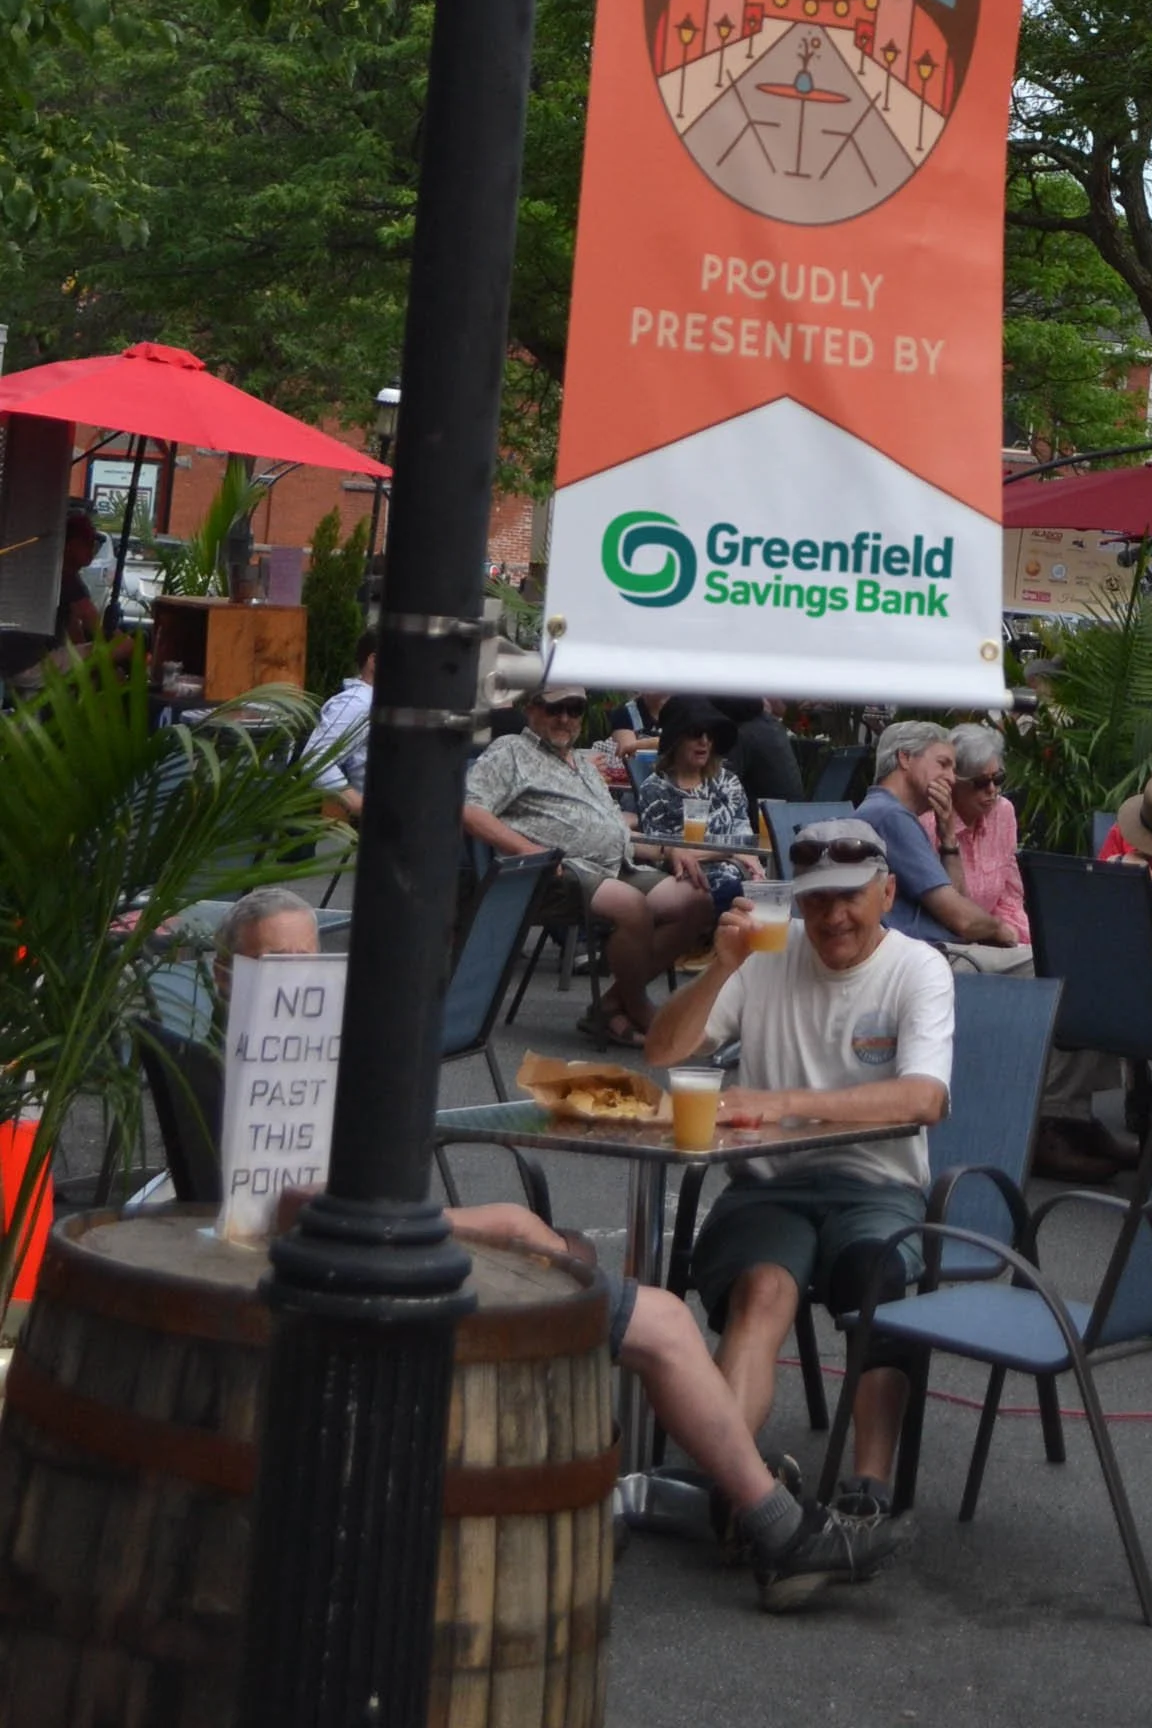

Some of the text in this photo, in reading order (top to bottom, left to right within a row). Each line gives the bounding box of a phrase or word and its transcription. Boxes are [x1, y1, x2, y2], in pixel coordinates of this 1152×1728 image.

[701, 253, 884, 311] PROUDLY
[629, 306, 945, 375] PRESENTED BY
[706, 522, 954, 579] Greenfield
[703, 570, 949, 618] Savings Bank
[273, 986, 326, 1019] NO
[235, 1032, 342, 1063] ALCOHO
[249, 1079, 327, 1107] PAST
[248, 1123, 315, 1151] THIS
